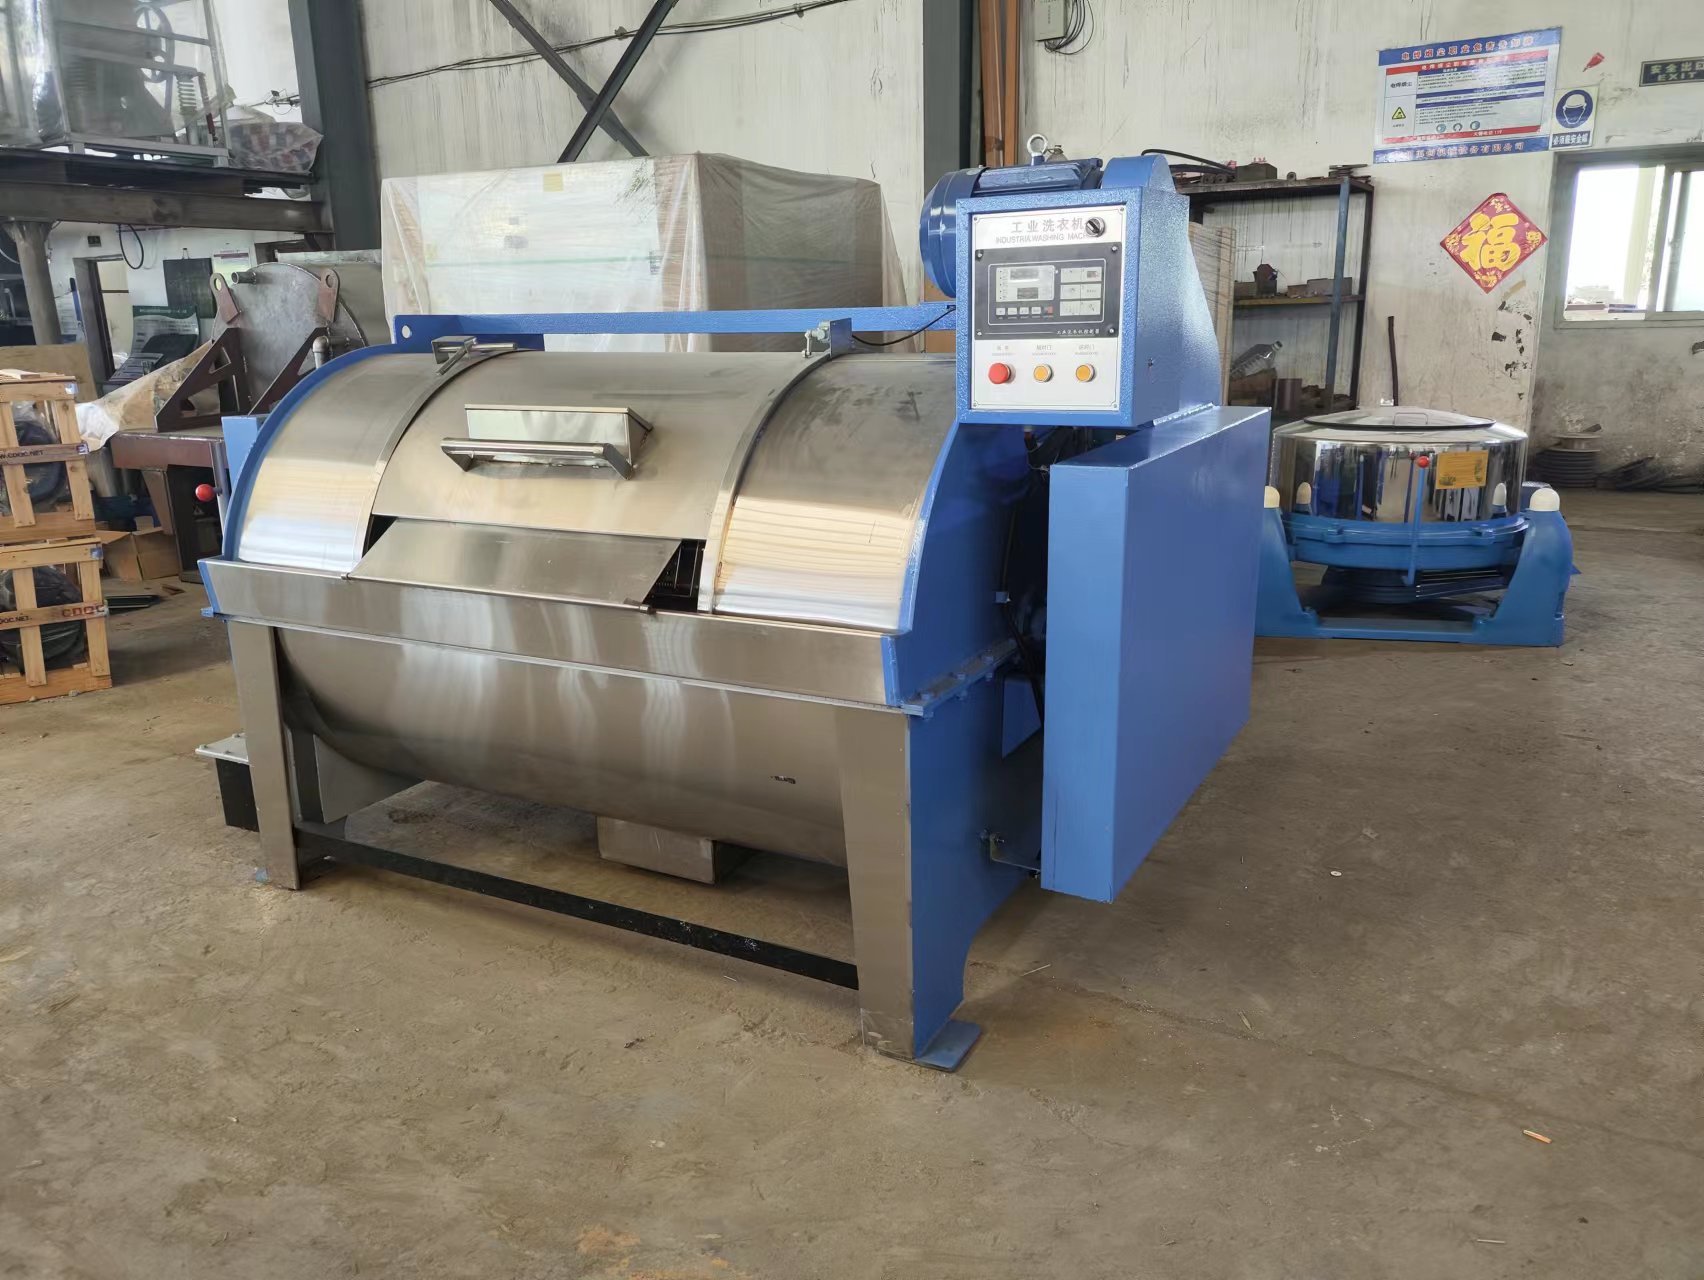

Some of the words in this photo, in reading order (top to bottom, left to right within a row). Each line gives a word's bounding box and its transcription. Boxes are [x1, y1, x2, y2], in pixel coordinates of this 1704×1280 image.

[1650, 61, 1704, 74] 安全出口
[1657, 72, 1697, 82] EXIT
[1010, 217, 1084, 234] 工业洗衣机
[1031, 233, 1065, 242] WASHING
[1460, 212, 1521, 272] 福
